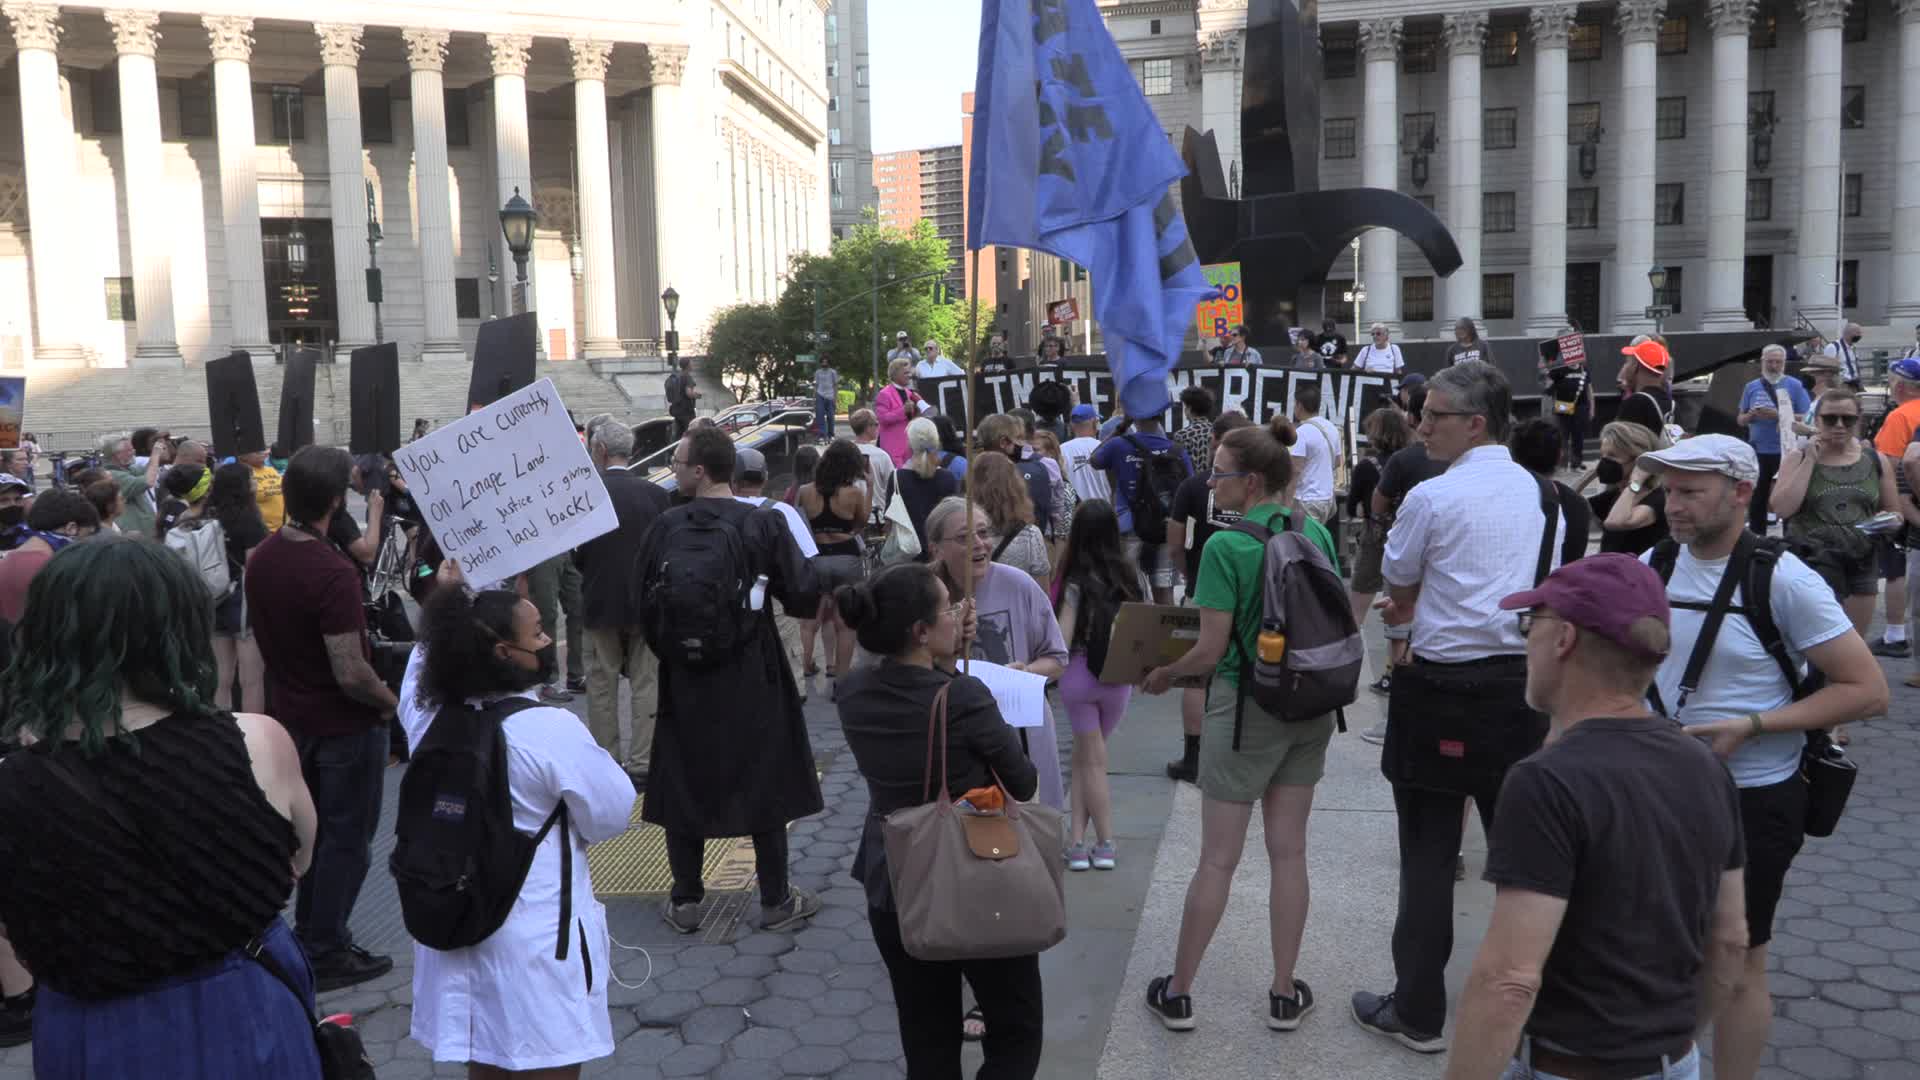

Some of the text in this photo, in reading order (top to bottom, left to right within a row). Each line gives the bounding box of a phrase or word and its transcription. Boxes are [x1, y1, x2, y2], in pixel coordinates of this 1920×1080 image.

[457, 425, 495, 455] are
[495, 390, 550, 431] currently
[430, 499, 454, 523] on
[442, 517, 489, 552] Climate
[541, 483, 554, 499] is
[562, 466, 592, 491] giving
[506, 518, 540, 547] land
